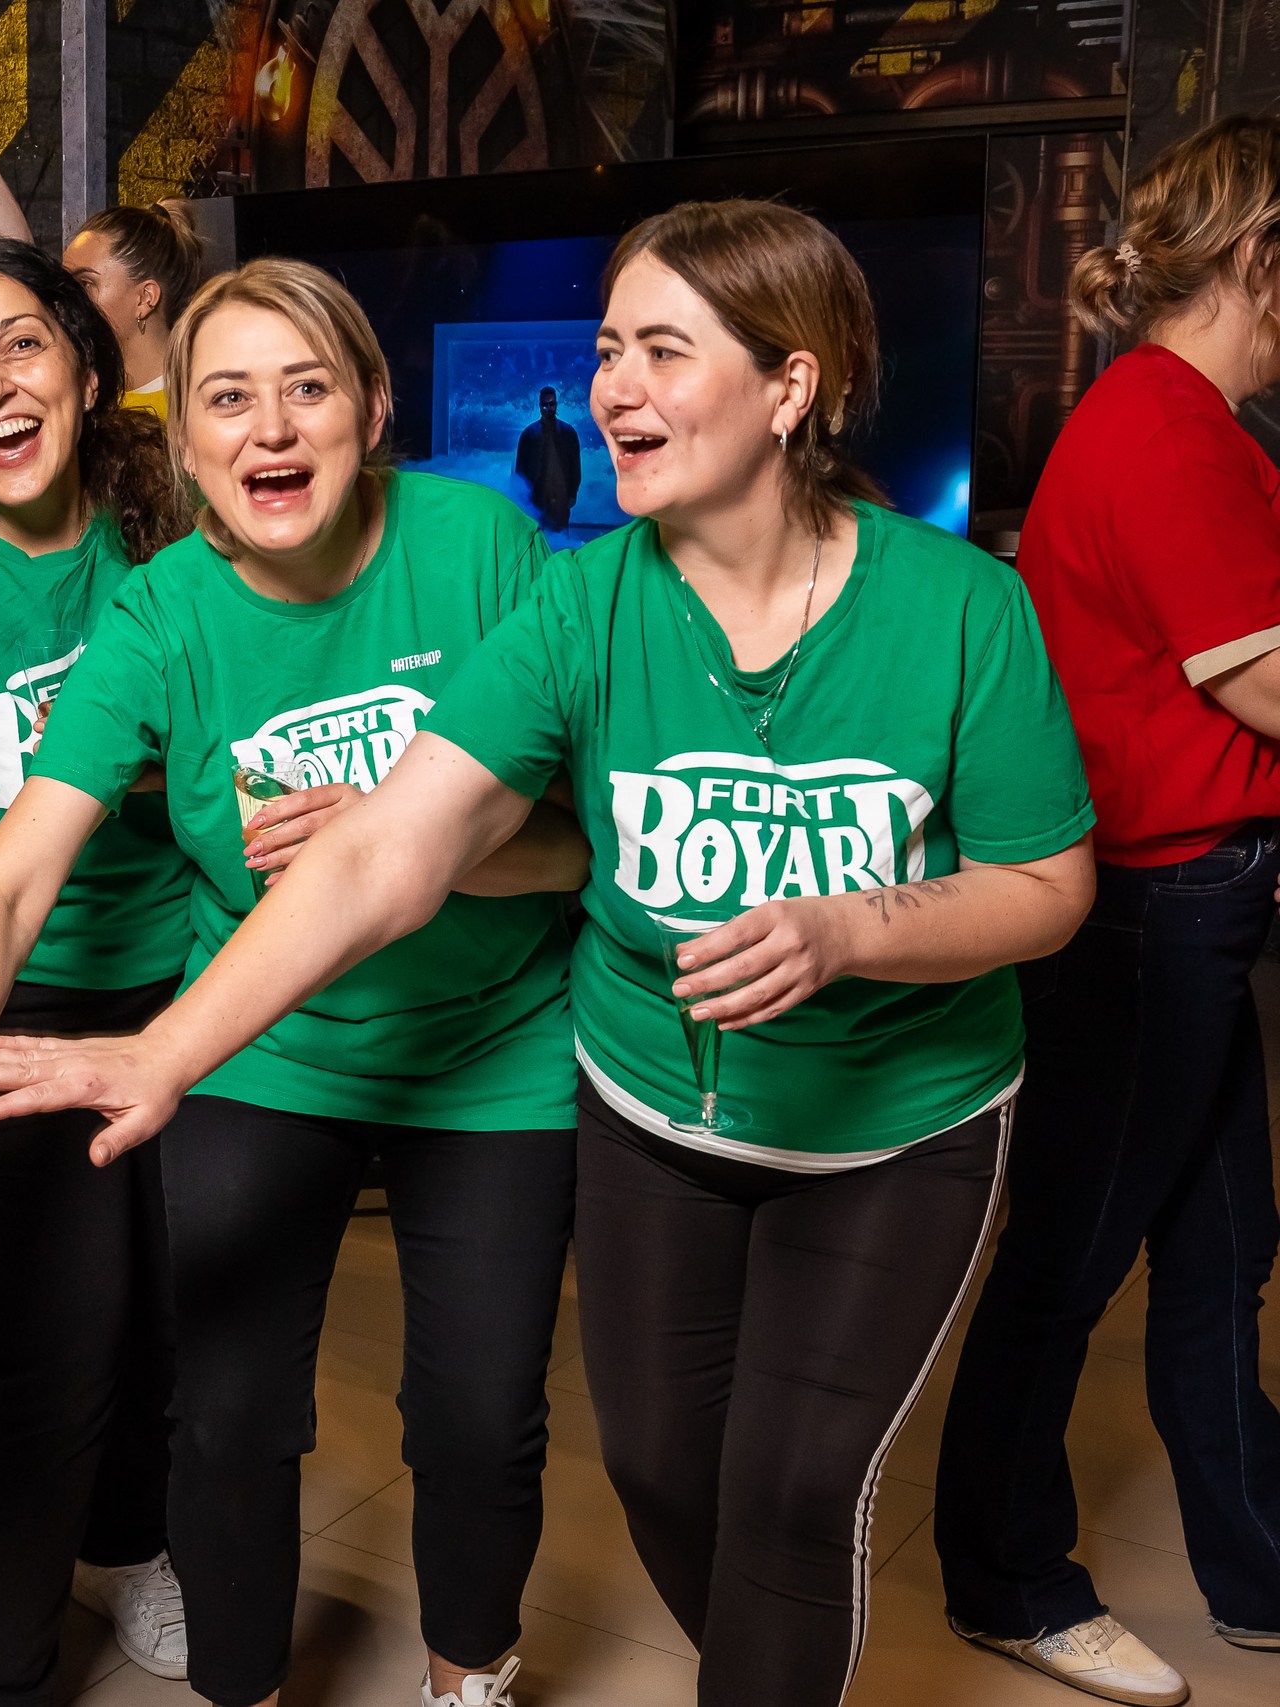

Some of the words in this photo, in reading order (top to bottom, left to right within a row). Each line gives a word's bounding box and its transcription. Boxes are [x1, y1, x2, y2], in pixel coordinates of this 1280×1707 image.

[286, 705, 382, 750] FORT
[697, 778, 840, 821] FORT
[609, 770, 935, 908] BOYARD
